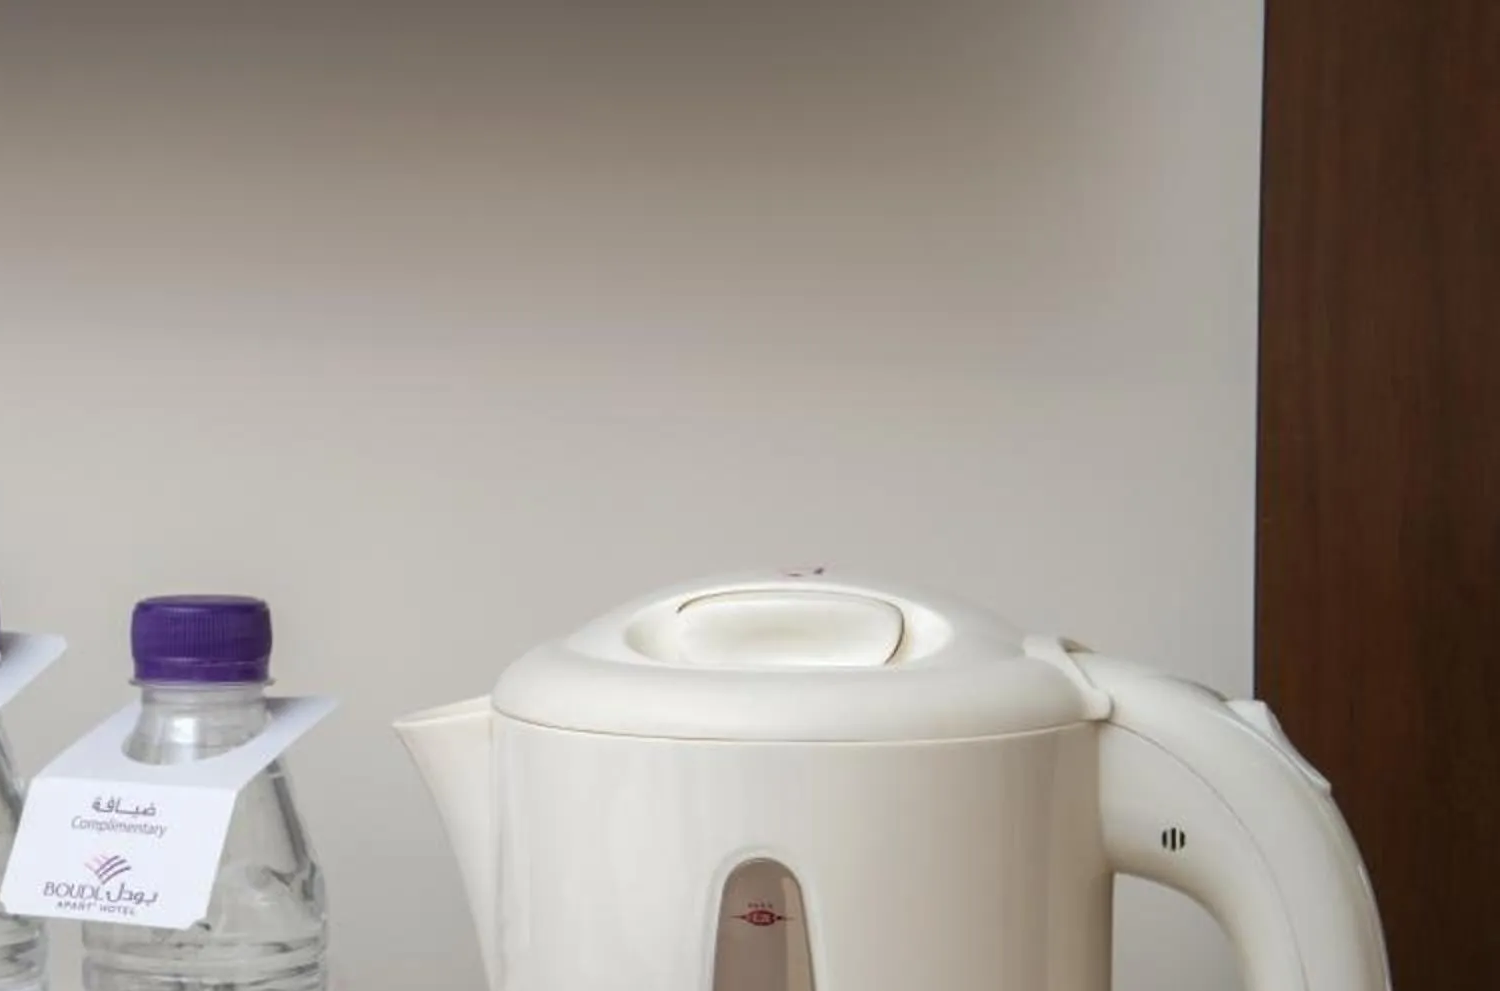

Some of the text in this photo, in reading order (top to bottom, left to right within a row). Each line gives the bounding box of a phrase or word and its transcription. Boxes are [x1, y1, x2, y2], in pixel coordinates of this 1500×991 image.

[71, 815, 167, 838] Complimentary
[42, 881, 103, 901] BOUDL
[99, 905, 135, 916] HOTEL
